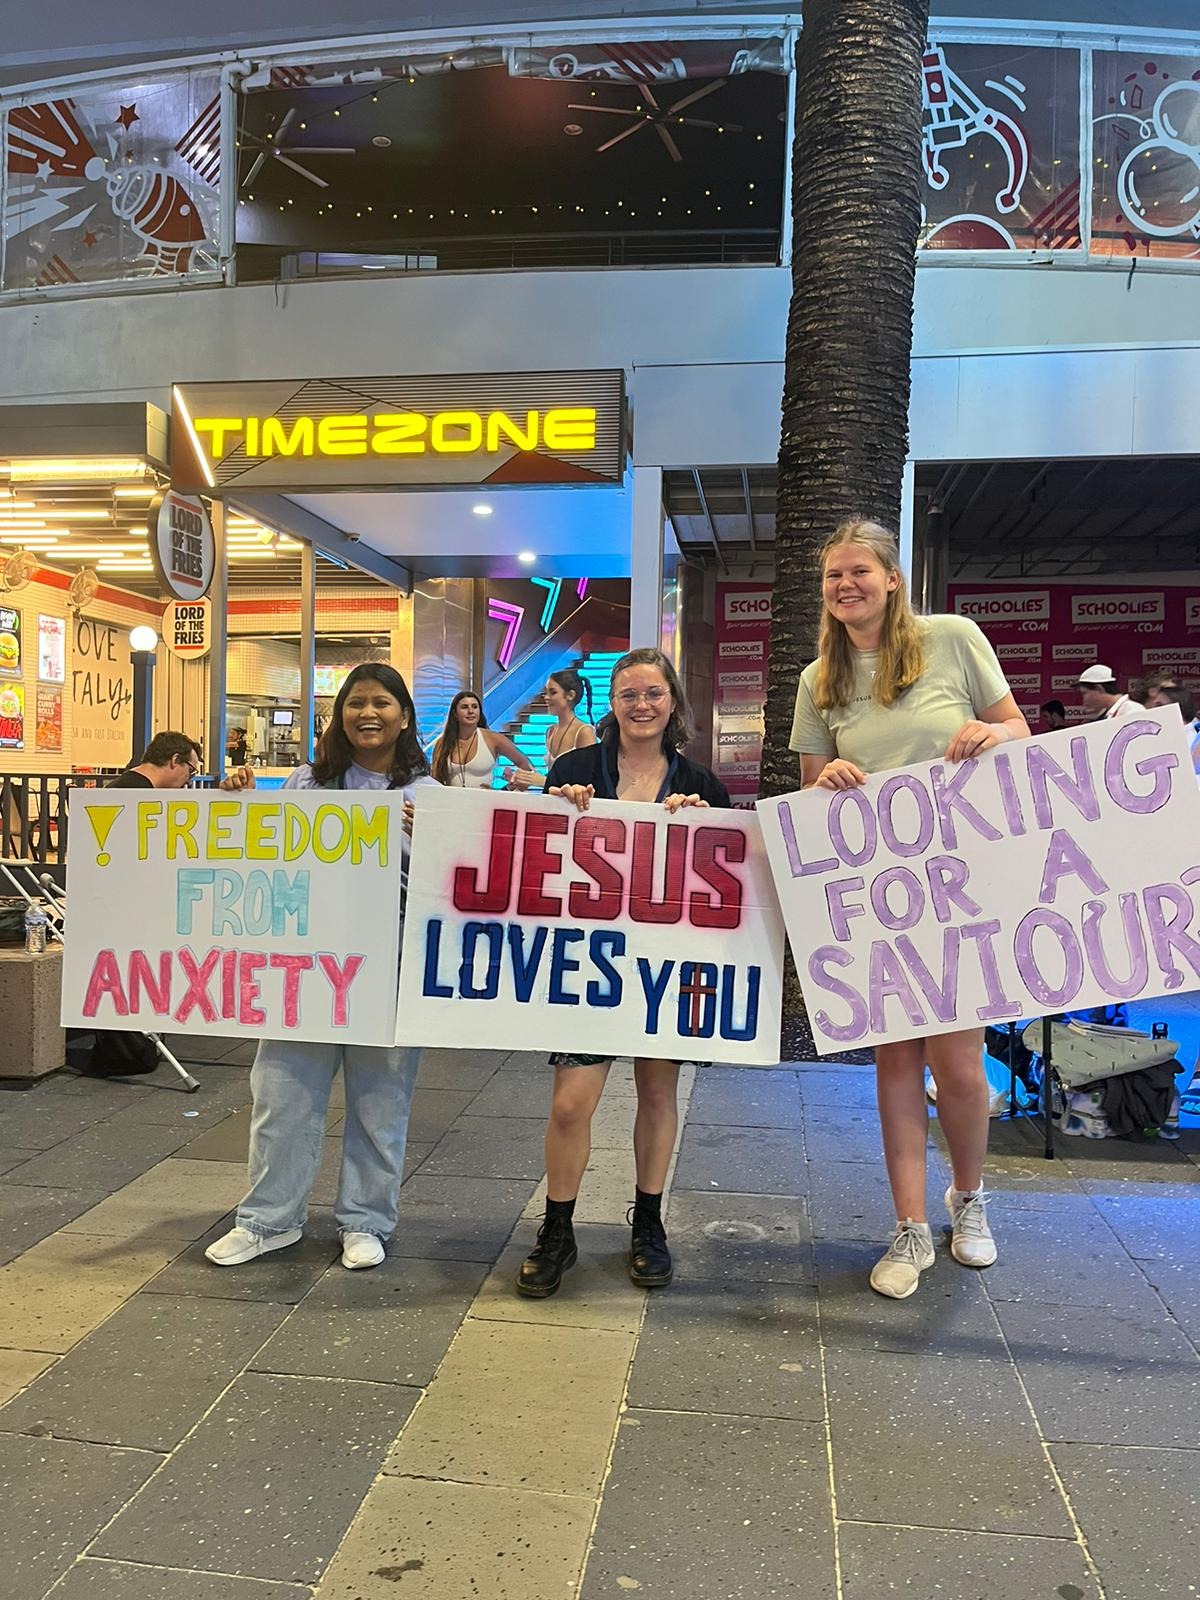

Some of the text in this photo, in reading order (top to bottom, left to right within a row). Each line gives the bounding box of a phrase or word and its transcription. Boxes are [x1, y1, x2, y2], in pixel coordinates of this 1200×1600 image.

[193, 408, 597, 458] TIMEZONE
[171, 505, 203, 537] LORD
[171, 529, 203, 557] OF THE
[171, 548, 203, 579] FRIES
[175, 606, 205, 621] LORD
[730, 599, 770, 613] SCHO
[960, 598, 1045, 615] SCHOOLIES
[1077, 600, 1159, 616] SCHOOLIES
[73, 621, 118, 662] OVE
[174, 631, 204, 645] FRIES
[175, 620, 204, 632] OF THE
[1018, 621, 1048, 632] .COM
[1134, 622, 1163, 633] .COM
[777, 719, 1180, 878] LOOKING
[137, 800, 390, 868] FREEDOM
[453, 808, 748, 930] JESUS
[825, 828, 1111, 942] FOR A
[176, 868, 311, 937] FROM
[82, 945, 368, 1028] ANXIETY
[421, 918, 762, 1042] LOVES YOU
